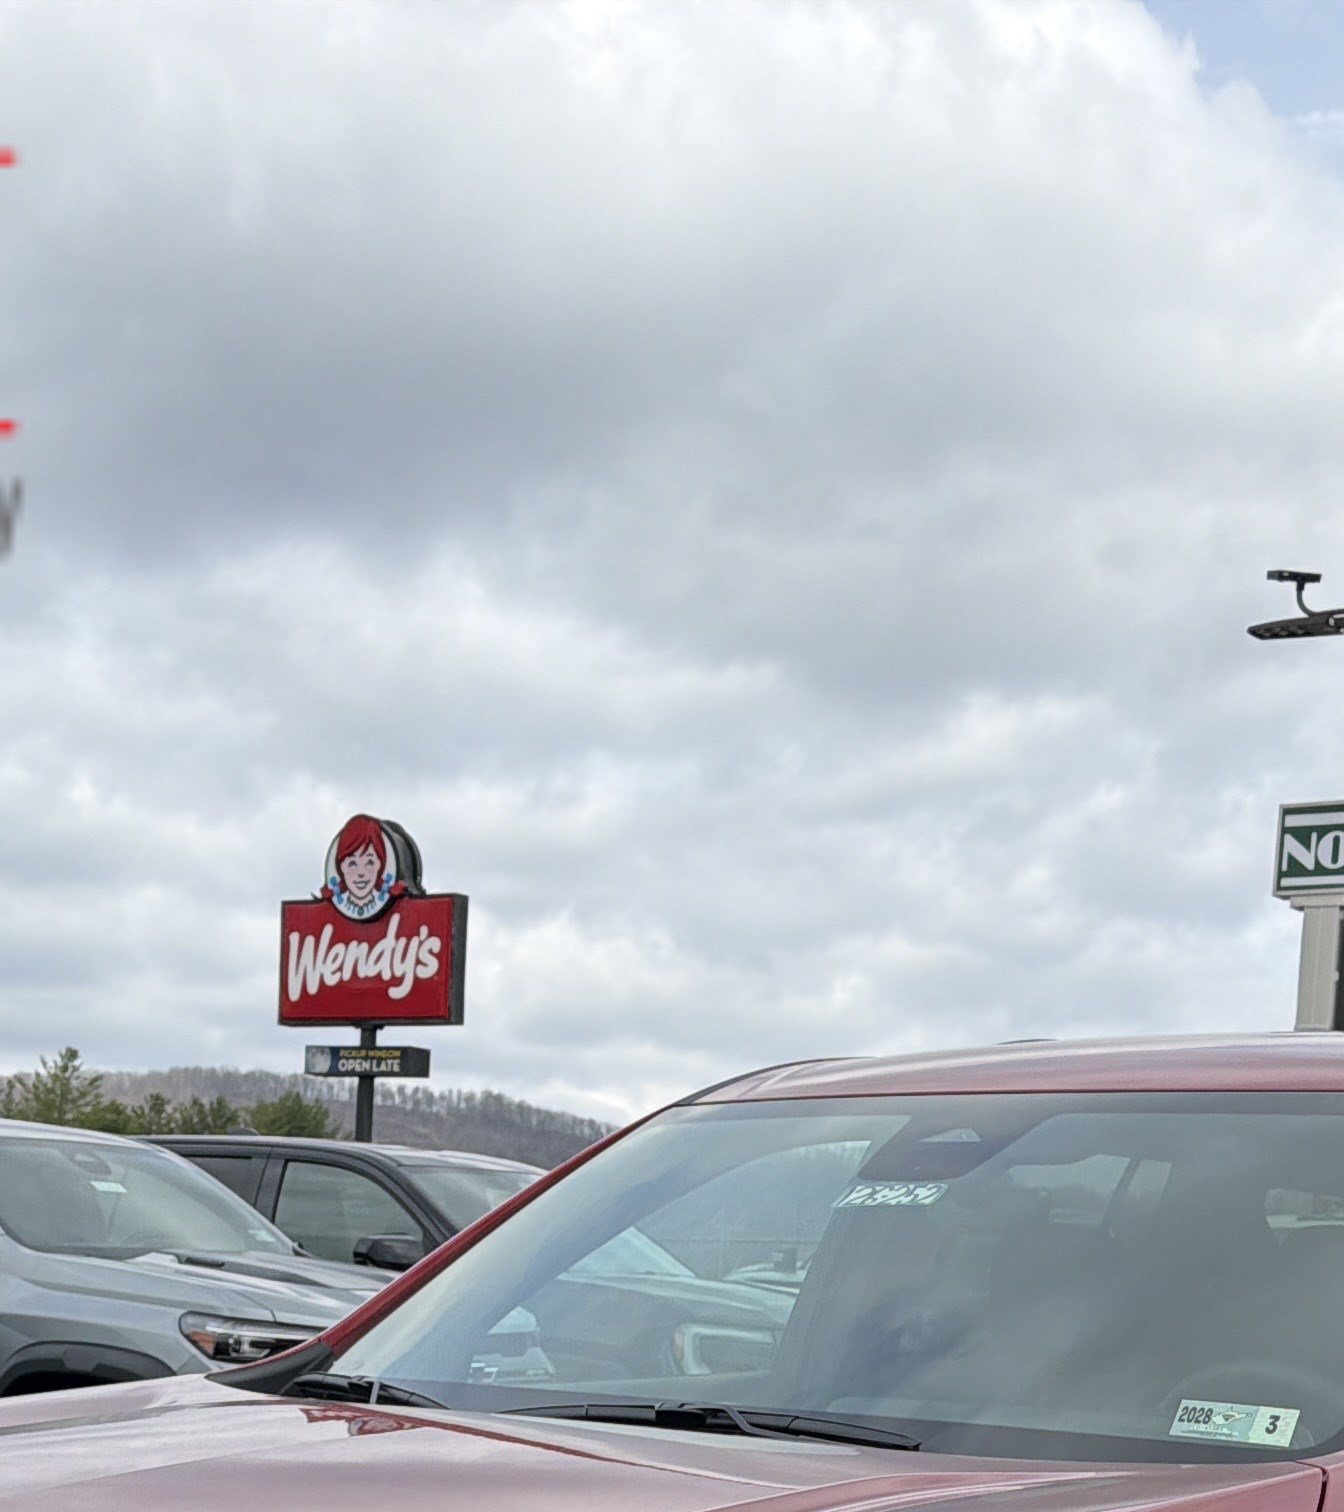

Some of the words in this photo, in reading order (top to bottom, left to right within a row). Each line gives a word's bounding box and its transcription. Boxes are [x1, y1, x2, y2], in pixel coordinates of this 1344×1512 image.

[287, 913, 442, 1002] Wendy's
[338, 1058, 370, 1072] OPEN
[372, 1058, 401, 1072] LATE
[1177, 1405, 1213, 1425] 2028
[1265, 1414, 1286, 1435] 3
